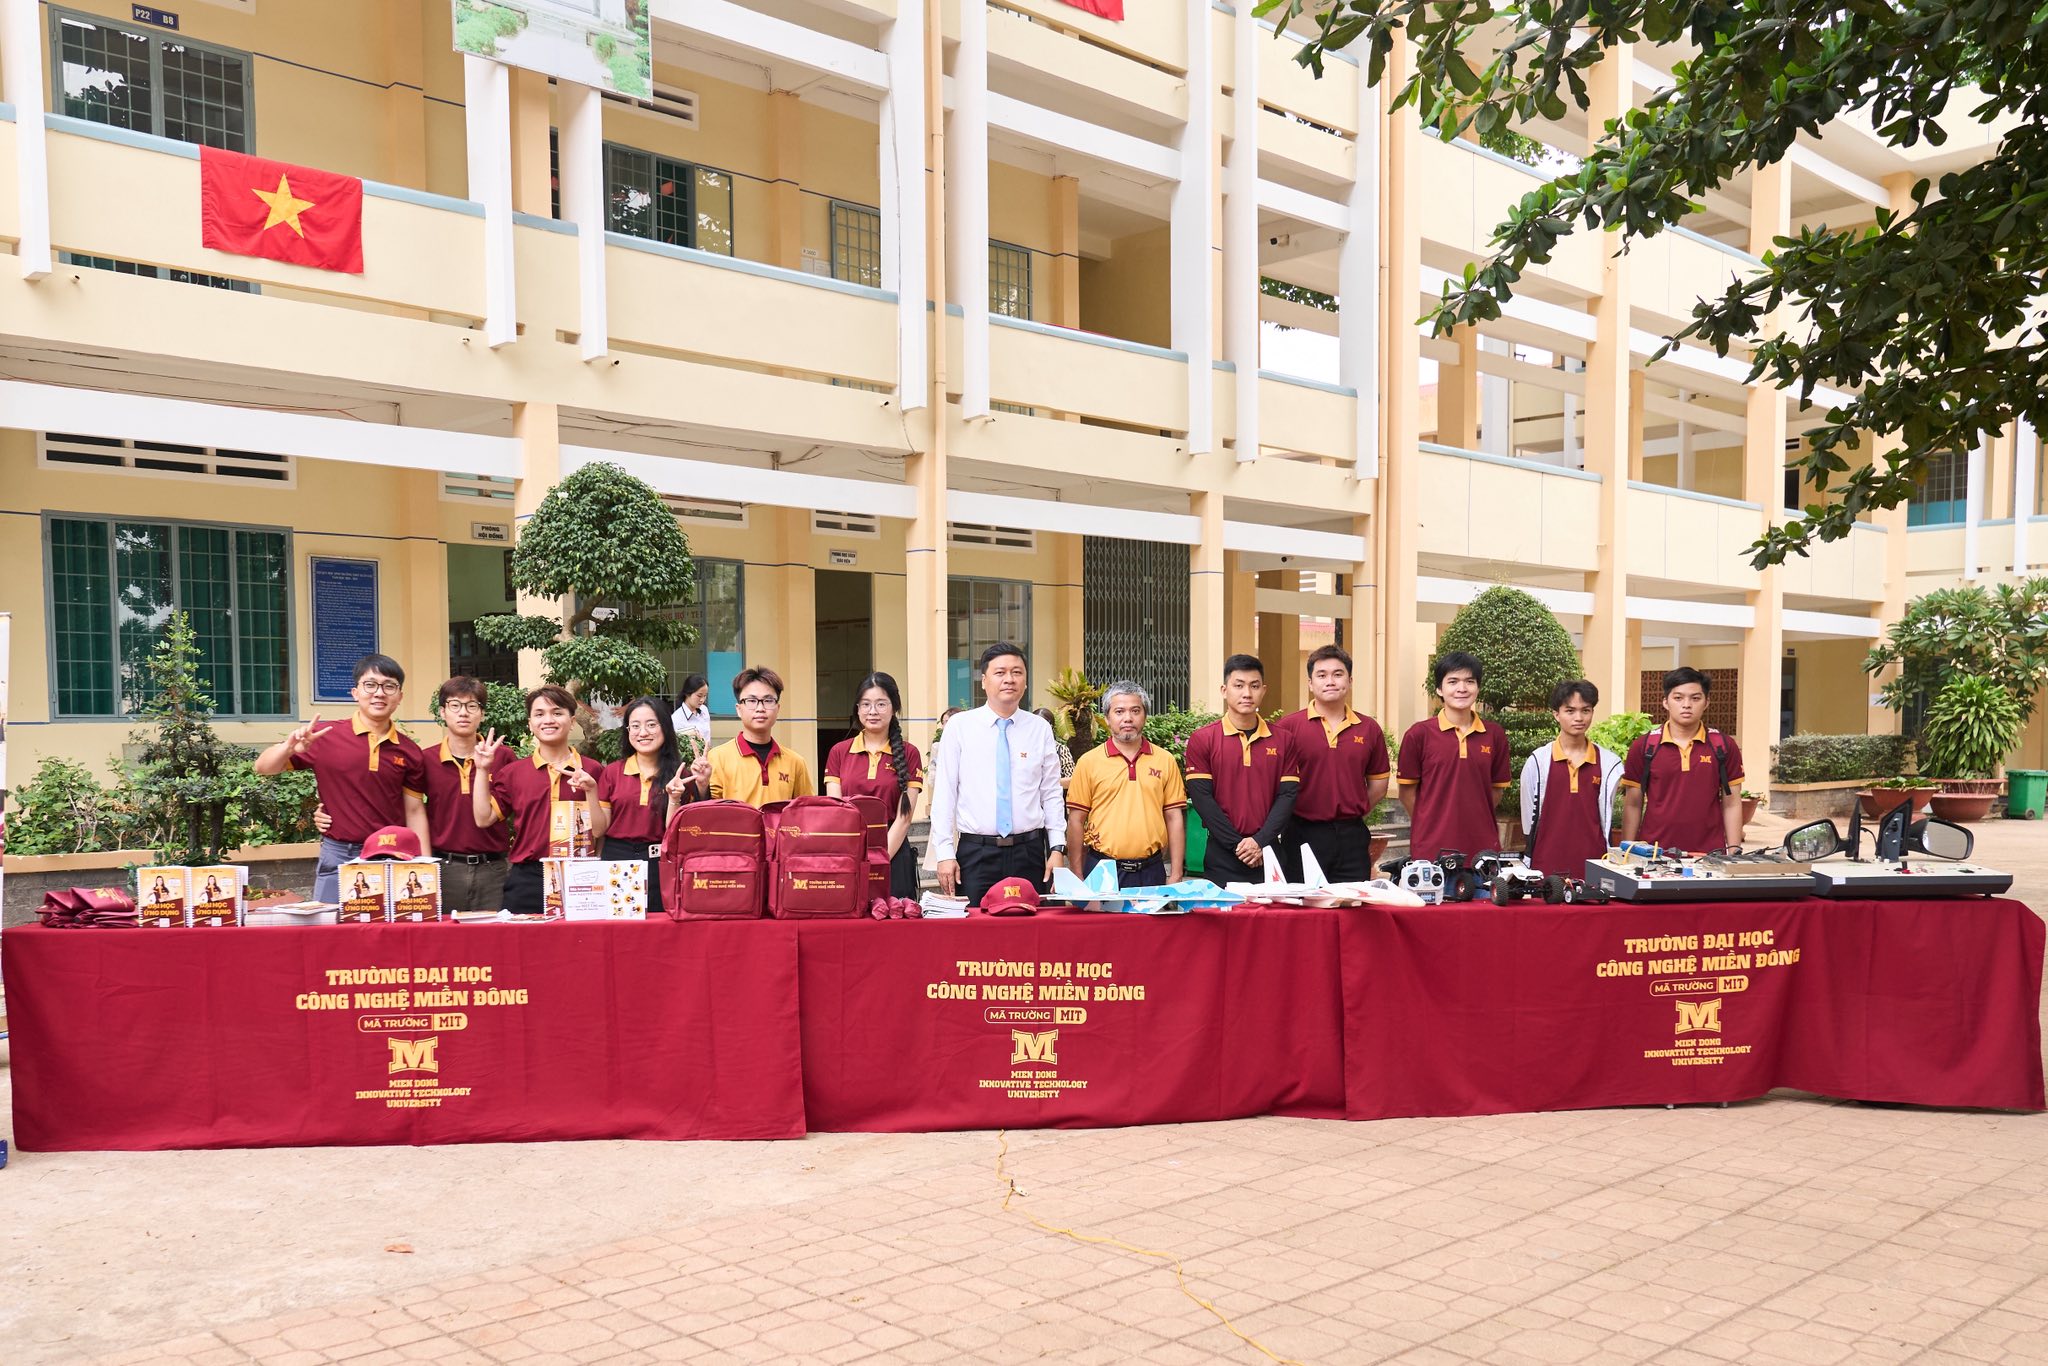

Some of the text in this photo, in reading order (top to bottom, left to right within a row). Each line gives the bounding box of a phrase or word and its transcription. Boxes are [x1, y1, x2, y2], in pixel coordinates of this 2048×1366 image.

[135, 8, 151, 20] P22
[1266, 747, 1278, 756] M
[1700, 755, 1712, 764] M
[778, 771, 790, 784] M
[1149, 767, 1162, 779] M
[378, 833, 397, 847] M
[693, 878, 708, 890] M
[793, 878, 808, 890] M
[1004, 885, 1021, 898] M
[160, 902, 176, 910] HỌC
[212, 902, 228, 910] HỌC
[361, 898, 376, 906] HỌC
[397, 903, 413, 911] ỨNG
[413, 897, 429, 905] HỌC
[1624, 930, 1774, 953] TRƯỜNG ĐẠI HỌC
[1596, 948, 1800, 977] CÔNG NGHỆ MIỀN ĐÔNG
[326, 966, 492, 985] TRƯỜNG ĐẠI HỌC
[956, 959, 1112, 980] TRƯỜNG ĐẠI HỌC
[1655, 978, 1744, 992] MÃ TRƯỜNG MIT
[296, 985, 528, 1010] CÔNG NGHỆ MIỀN ĐÔNG
[927, 980, 1145, 1003] CÔNG NGHỆ MIỀN ĐÔNG
[990, 1009, 1082, 1021] MÃ TRƯỜNG MIT
[1675, 998, 1721, 1034] M
[364, 1016, 462, 1028] MÃ TRƯỜNG MIT
[1011, 1029, 1058, 1065] M
[1675, 1038, 1721, 1047] MIEN DONG
[388, 1036, 438, 1074] M
[1644, 1046, 1751, 1058] INNOVATIVE TECHNOLOGY
[1672, 1057, 1724, 1066] UNIVERSITY
[1035, 1071, 1057, 1079] DONG
[389, 1079, 438, 1088] MIEN DONG
[979, 1080, 1031, 1088] INNOVATIVE
[356, 1088, 471, 1099] INNOVATIVE TECHNOLOGY
[1008, 1090, 1060, 1098] UNIVERSITY
[387, 1099, 441, 1107] UNIVERSITY
